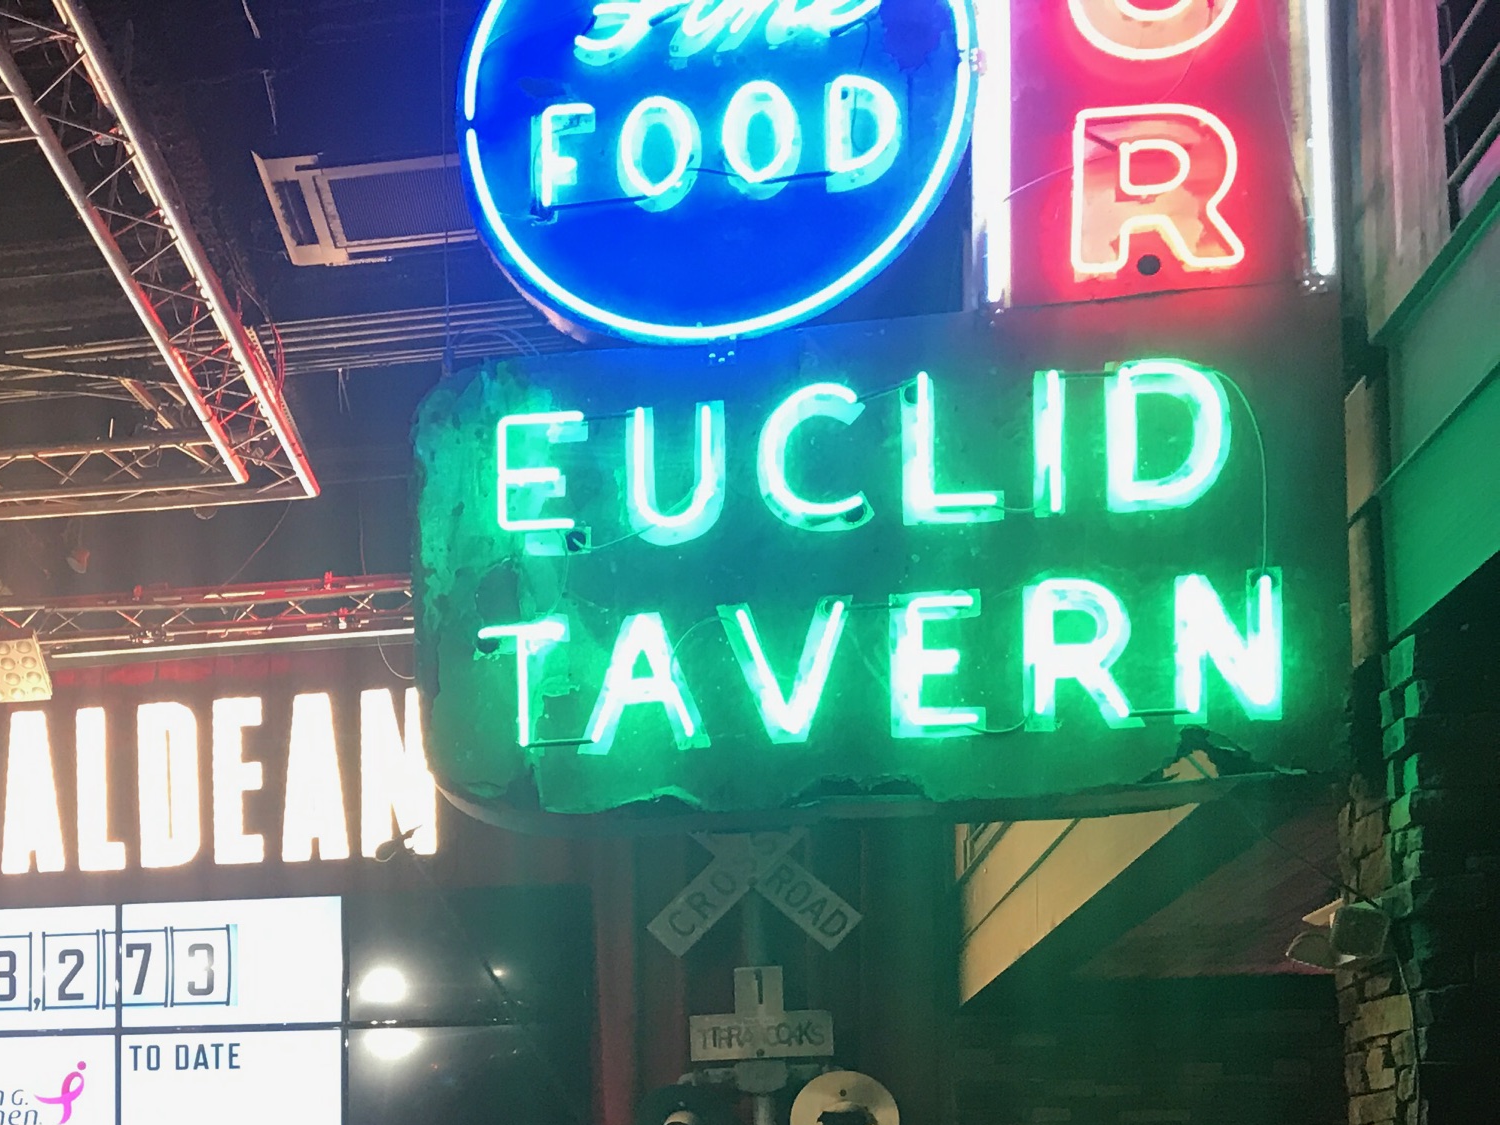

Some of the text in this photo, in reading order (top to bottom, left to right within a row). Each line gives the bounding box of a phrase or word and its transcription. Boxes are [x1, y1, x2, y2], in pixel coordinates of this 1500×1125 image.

[534, 74, 900, 212] FOOD
[498, 358, 1232, 550] EUCLID
[478, 574, 1283, 754] TAVERN
[0, 686, 438, 876] ALDEAN
[764, 862, 849, 937] ROAD
[128, 1042, 241, 1071] TO DATE
